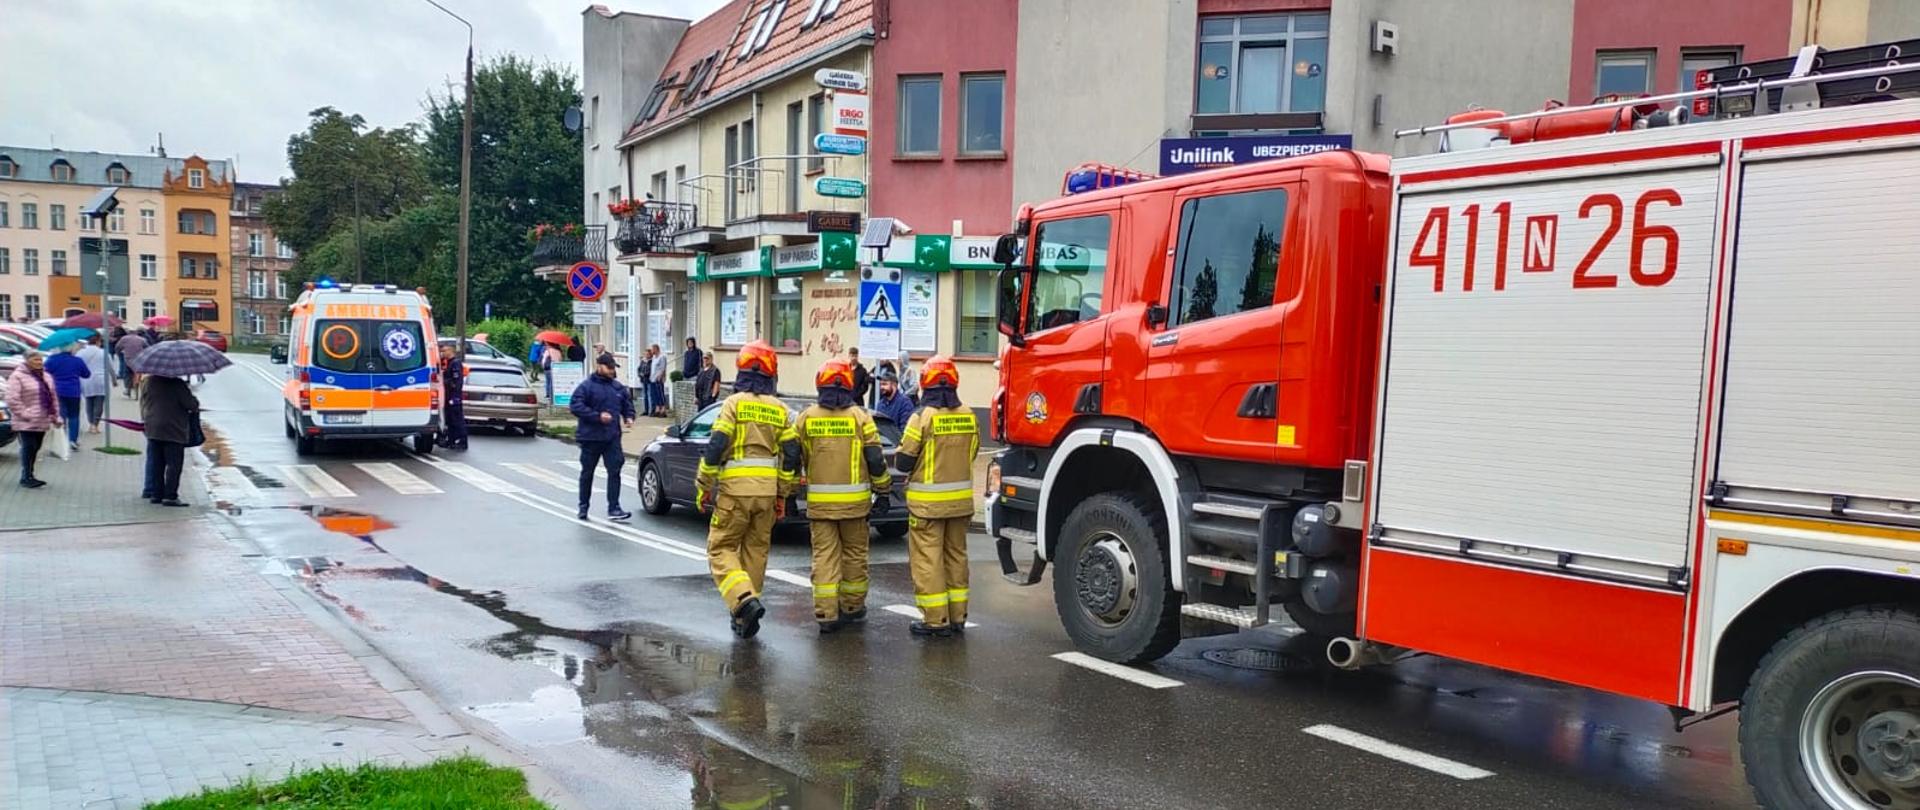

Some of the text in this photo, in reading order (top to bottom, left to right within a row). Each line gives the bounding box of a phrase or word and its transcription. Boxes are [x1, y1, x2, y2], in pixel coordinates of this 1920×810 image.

[840, 109, 864, 118] ERGO
[1170, 147, 1235, 164] Unilink
[1409, 188, 1683, 292] 411 N 26
[968, 246, 994, 259] BN
[326, 304, 408, 318] AMBULANS
[333, 333, 347, 352] P
